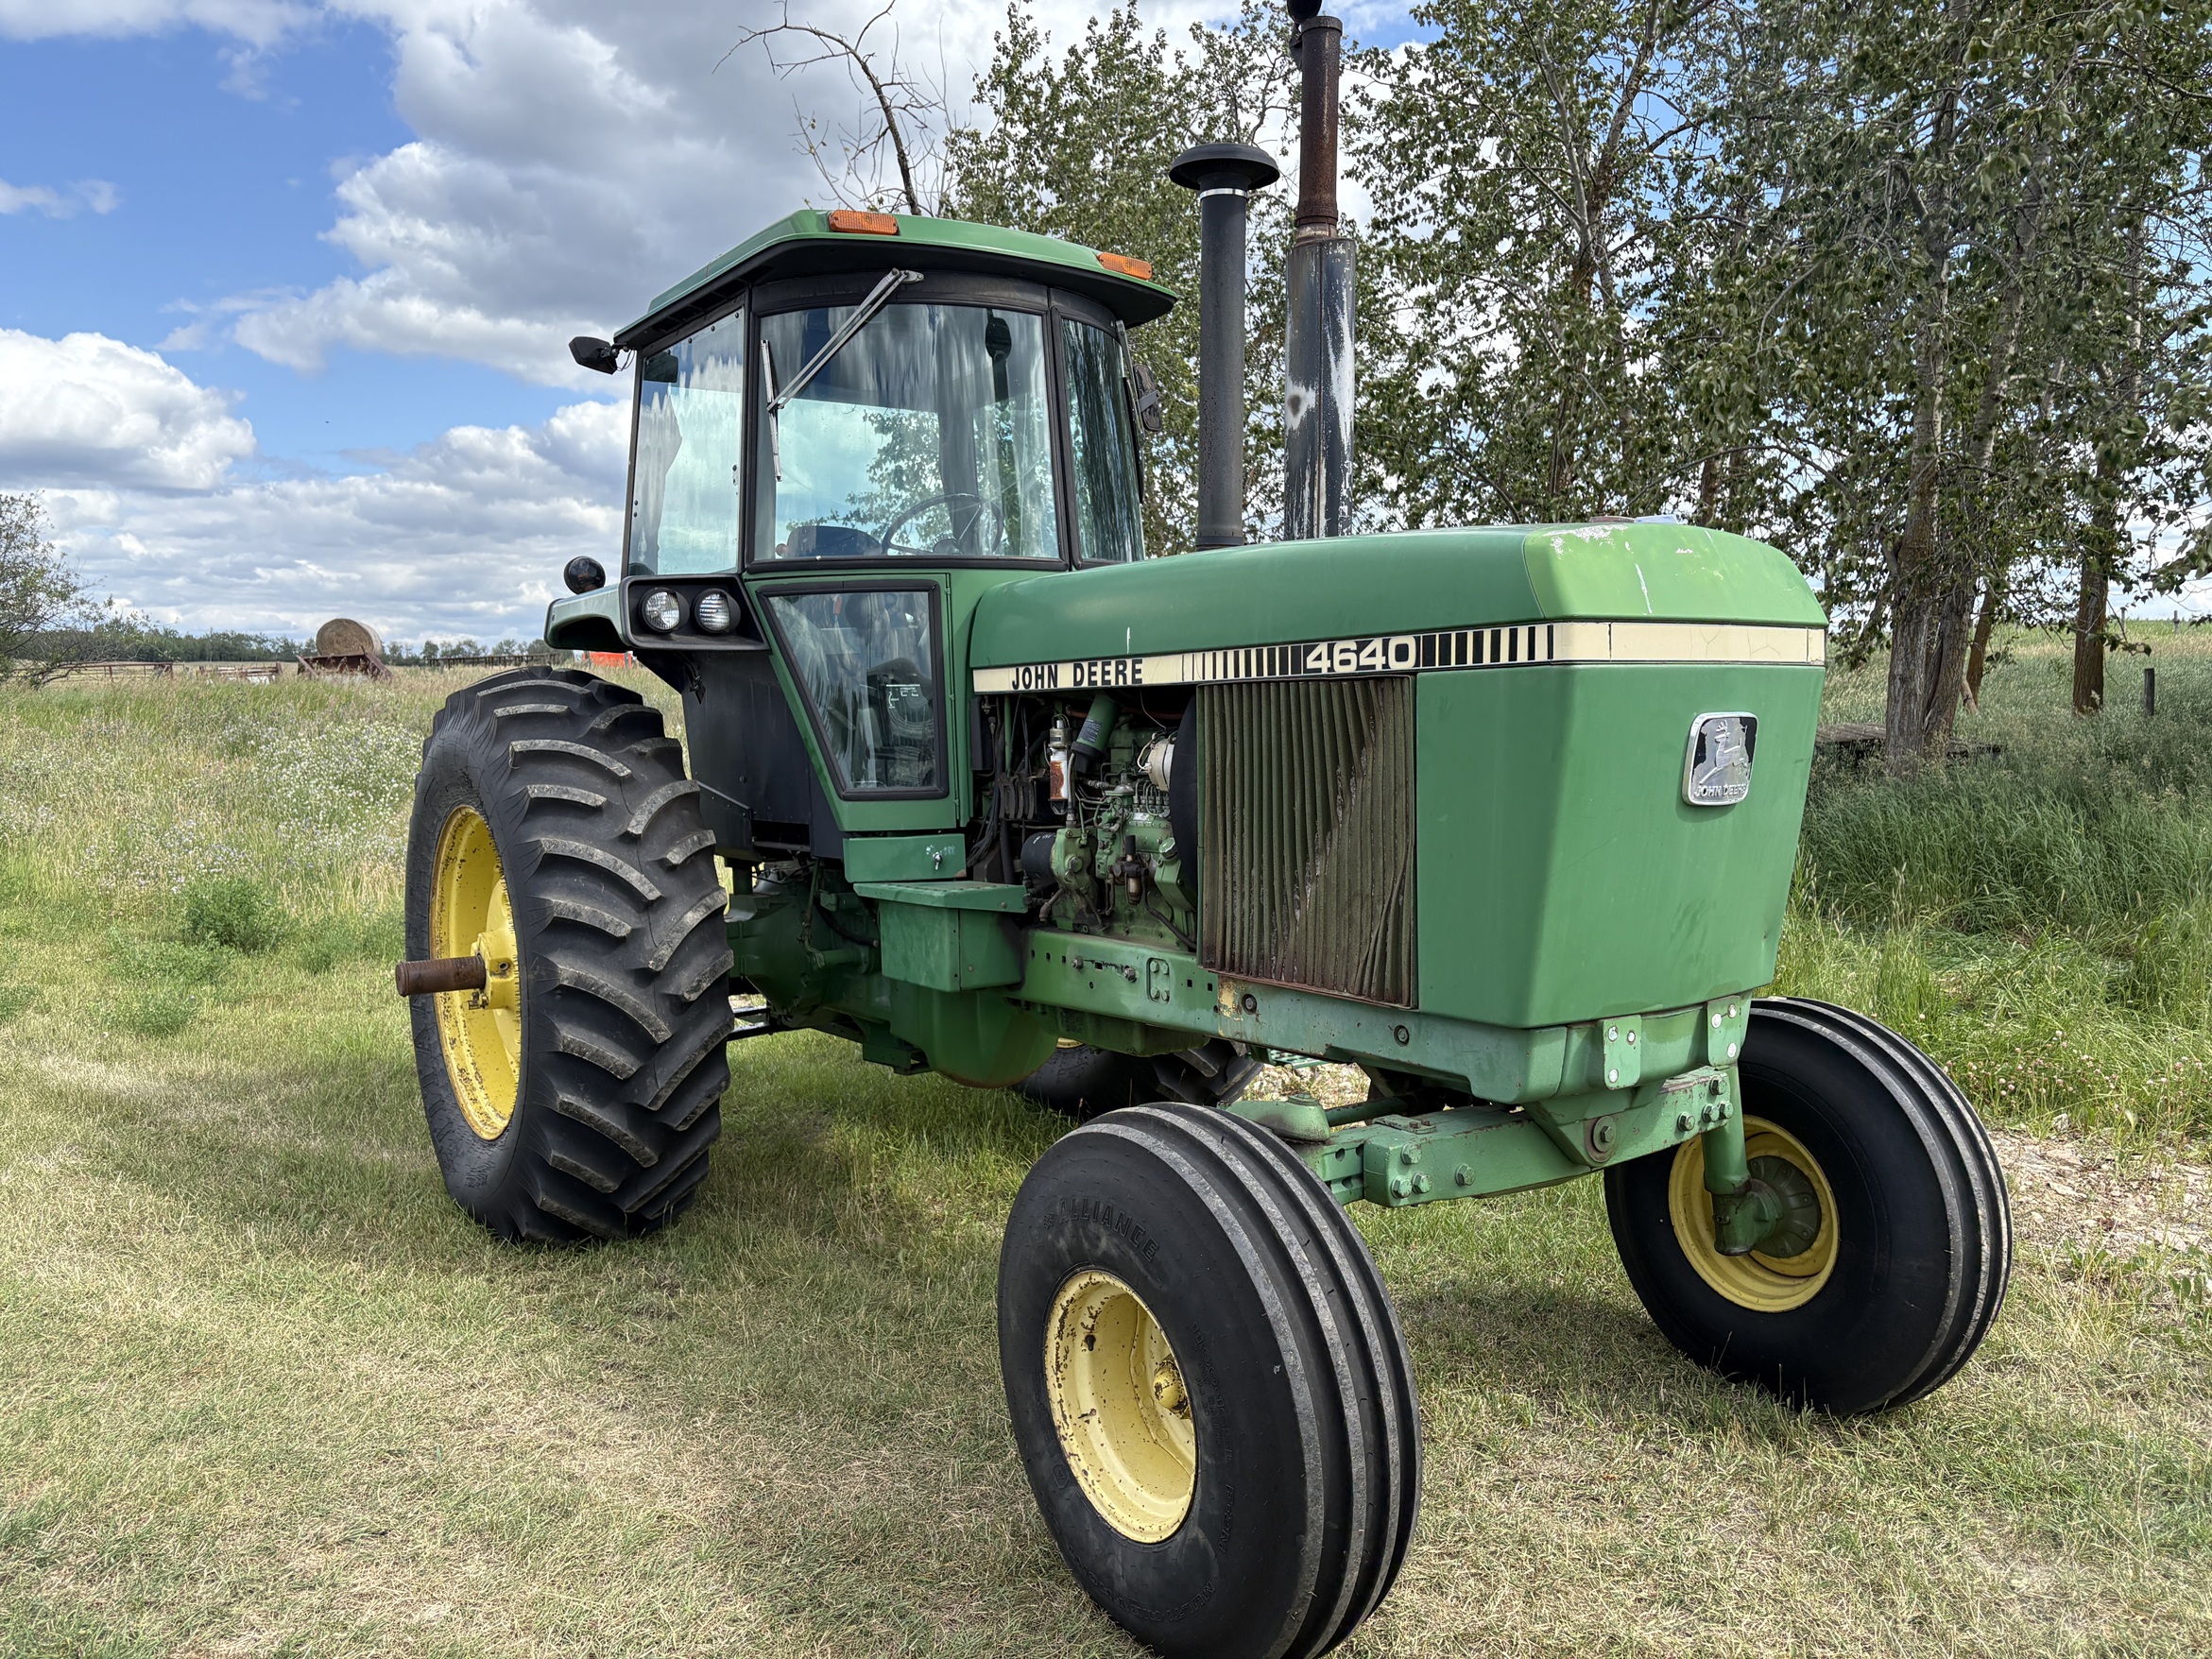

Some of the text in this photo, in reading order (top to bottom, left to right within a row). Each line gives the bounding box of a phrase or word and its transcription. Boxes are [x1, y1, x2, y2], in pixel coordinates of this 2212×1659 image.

[1306, 636, 1416, 674] 4640
[1012, 658, 1142, 691] JOHN DEERE
[1694, 783, 1746, 797] JOHN DEERE
[1058, 1195, 1159, 1262] ALLIANCE
[1165, 1581, 1216, 1622] MULTI
